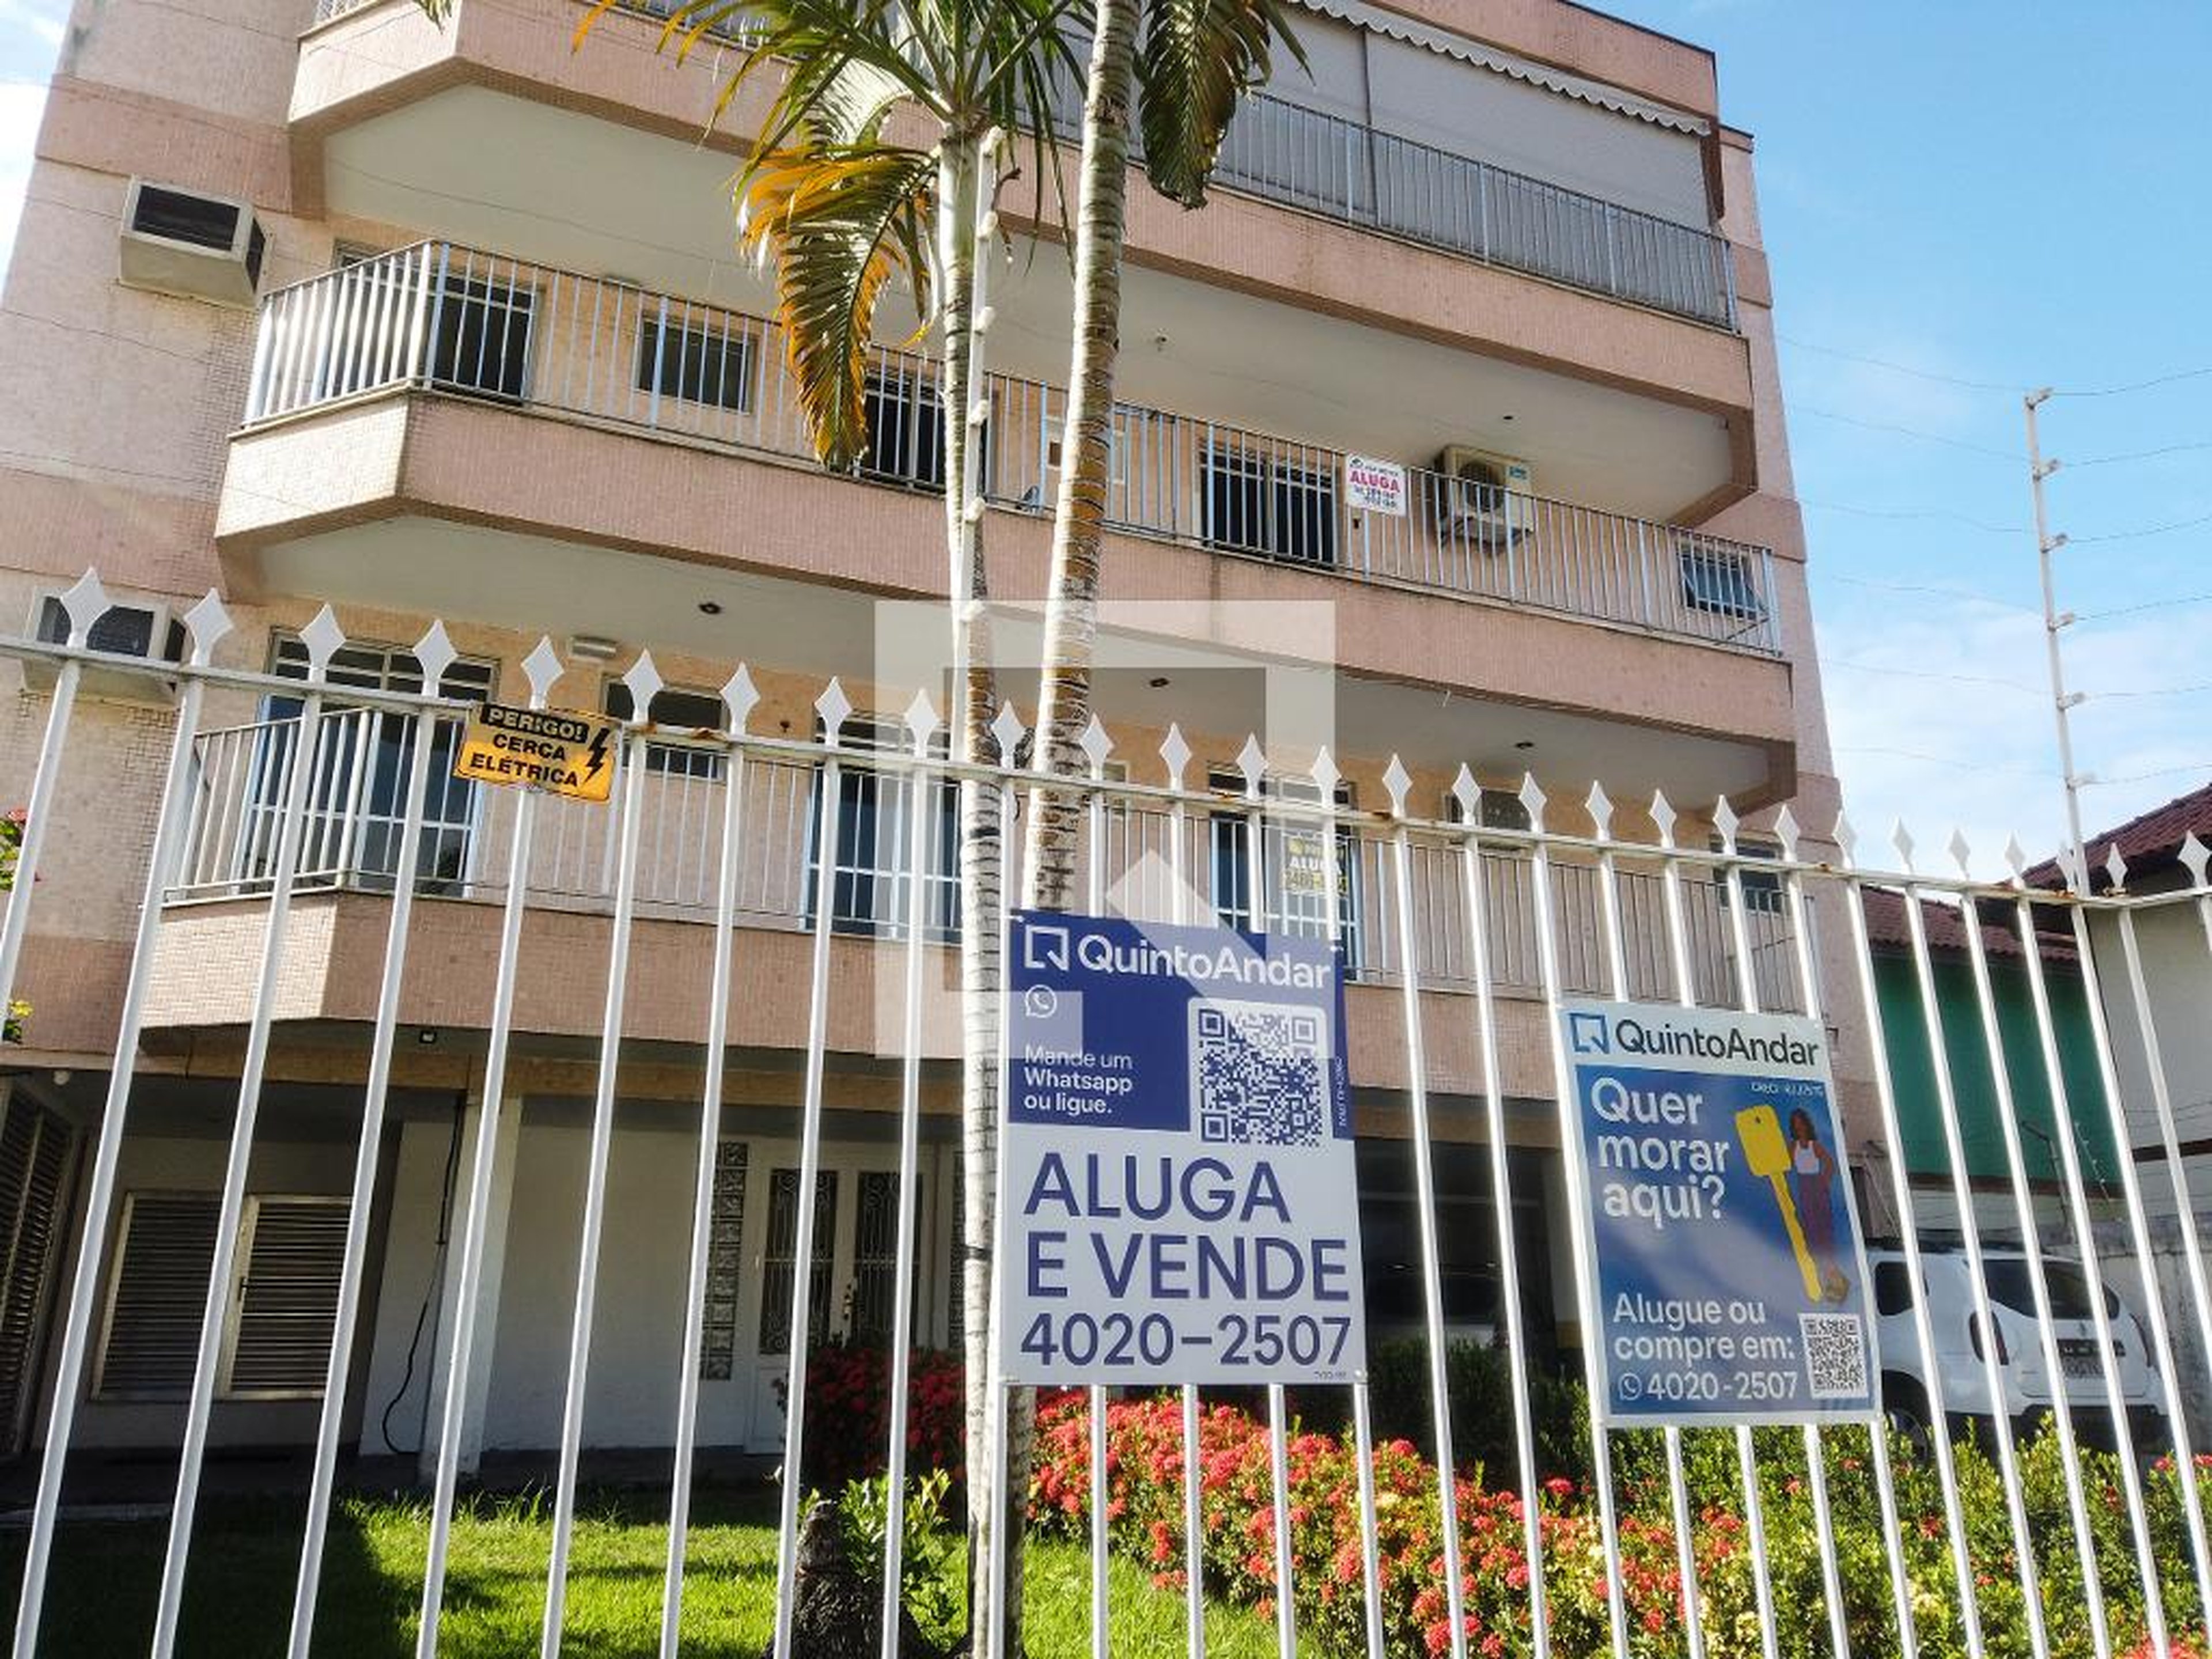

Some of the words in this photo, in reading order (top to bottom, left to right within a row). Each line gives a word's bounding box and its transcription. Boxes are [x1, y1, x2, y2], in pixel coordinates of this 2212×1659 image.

[1350, 471, 1400, 493] ALUGA
[488, 707, 583, 740] PERIGO!
[493, 733, 566, 761] CERCA
[470, 752, 578, 787] ELÉTRICA
[1077, 934, 1331, 990] QuintoAndar
[1024, 1045, 1096, 1067] Mande
[1100, 1054, 1133, 1069] um
[1615, 1018, 1819, 1066] QuintoAndar
[1024, 1067, 1133, 1096] Whatsapp
[1024, 1093, 1051, 1111] ou
[1055, 1092, 1113, 1116] ligue.
[1590, 1077, 1703, 1125] Quer
[1597, 1133, 1729, 1173] morar
[1022, 1152, 1291, 1224] ALUGA
[1603, 1173, 1725, 1229] aqui?
[1027, 1231, 1068, 1297] E
[1089, 1232, 1350, 1301] VENDE
[1613, 1293, 1722, 1330] Alugue
[1728, 1301, 1766, 1324] ou
[1021, 1312, 1351, 1366] 4020-2507
[1614, 1334, 1735, 1368] compre
[1743, 1336, 1795, 1361] em:
